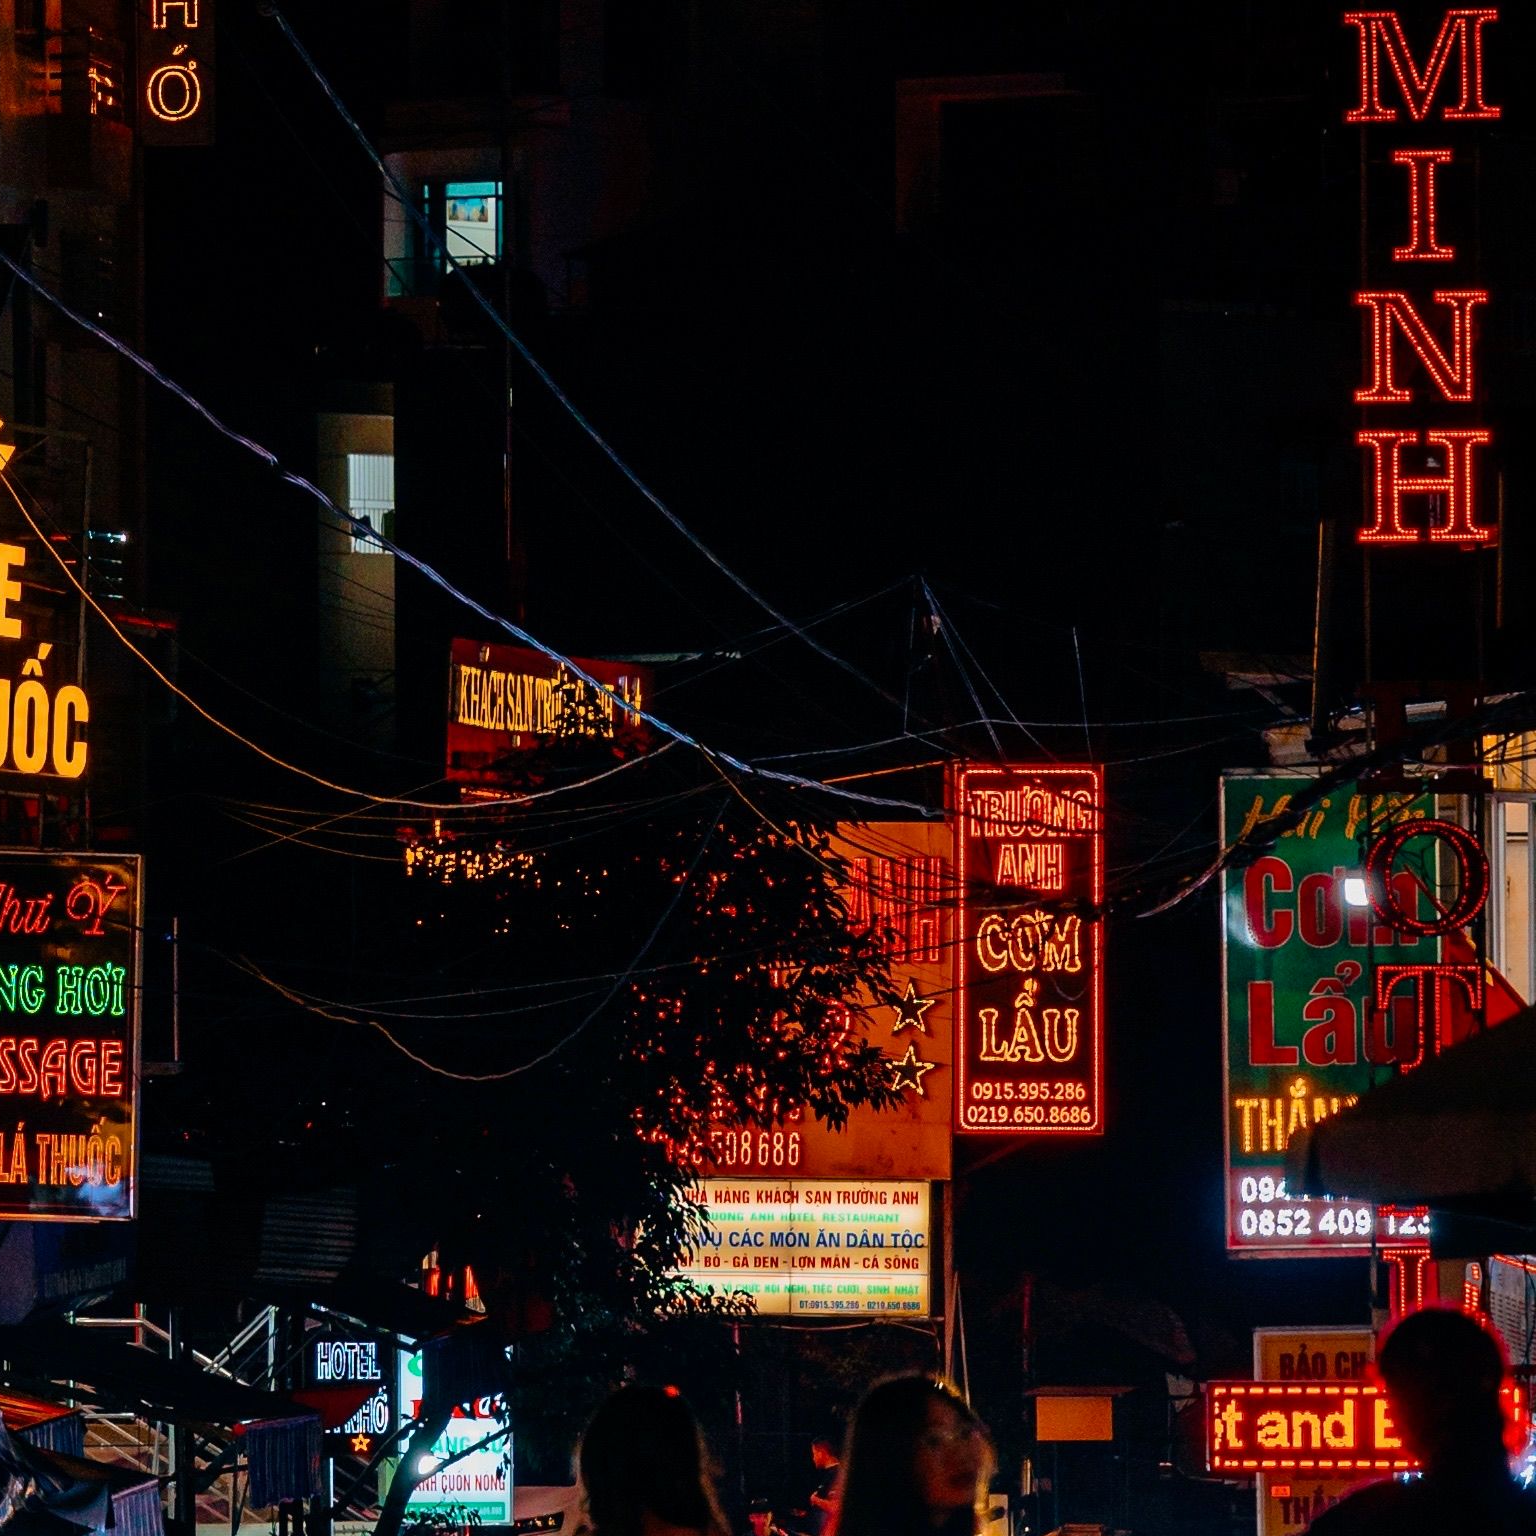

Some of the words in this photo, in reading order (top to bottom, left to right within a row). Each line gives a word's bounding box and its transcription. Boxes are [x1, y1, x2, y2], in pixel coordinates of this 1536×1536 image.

[1343, 8, 1504, 543] MINH
[996, 844, 1064, 891] ANH
[66, 873, 127, 936] Ý
[56, 961, 126, 1016] HƠI
[971, 1082, 1087, 1101] 0915.395.286
[967, 1105, 1092, 1125] 0219.650.8686
[36, 1116, 122, 1187] THUỐC
[714, 1186, 751, 1204] HÀNG
[756, 1186, 800, 1204] KHÁCH
[805, 1190, 832, 1207] SẠN
[836, 1186, 888, 1205] TRƯỜNG
[892, 1191, 920, 1205] ANH
[728, 1227, 765, 1248] CÁC
[770, 1226, 810, 1248] MÓN
[815, 1227, 841, 1248] ĂN
[846, 1228, 885, 1249] DÂN
[890, 1228, 925, 1253] TỘC
[1241, 1208, 1312, 1236] 0852
[1318, 1208, 1372, 1236] 409
[862, 1253, 879, 1270] CÁ
[884, 1254, 920, 1270] SÔNG
[317, 1342, 381, 1380] HOTEL
[1279, 1343, 1328, 1380] BẢO
[1257, 1398, 1355, 1449] and
